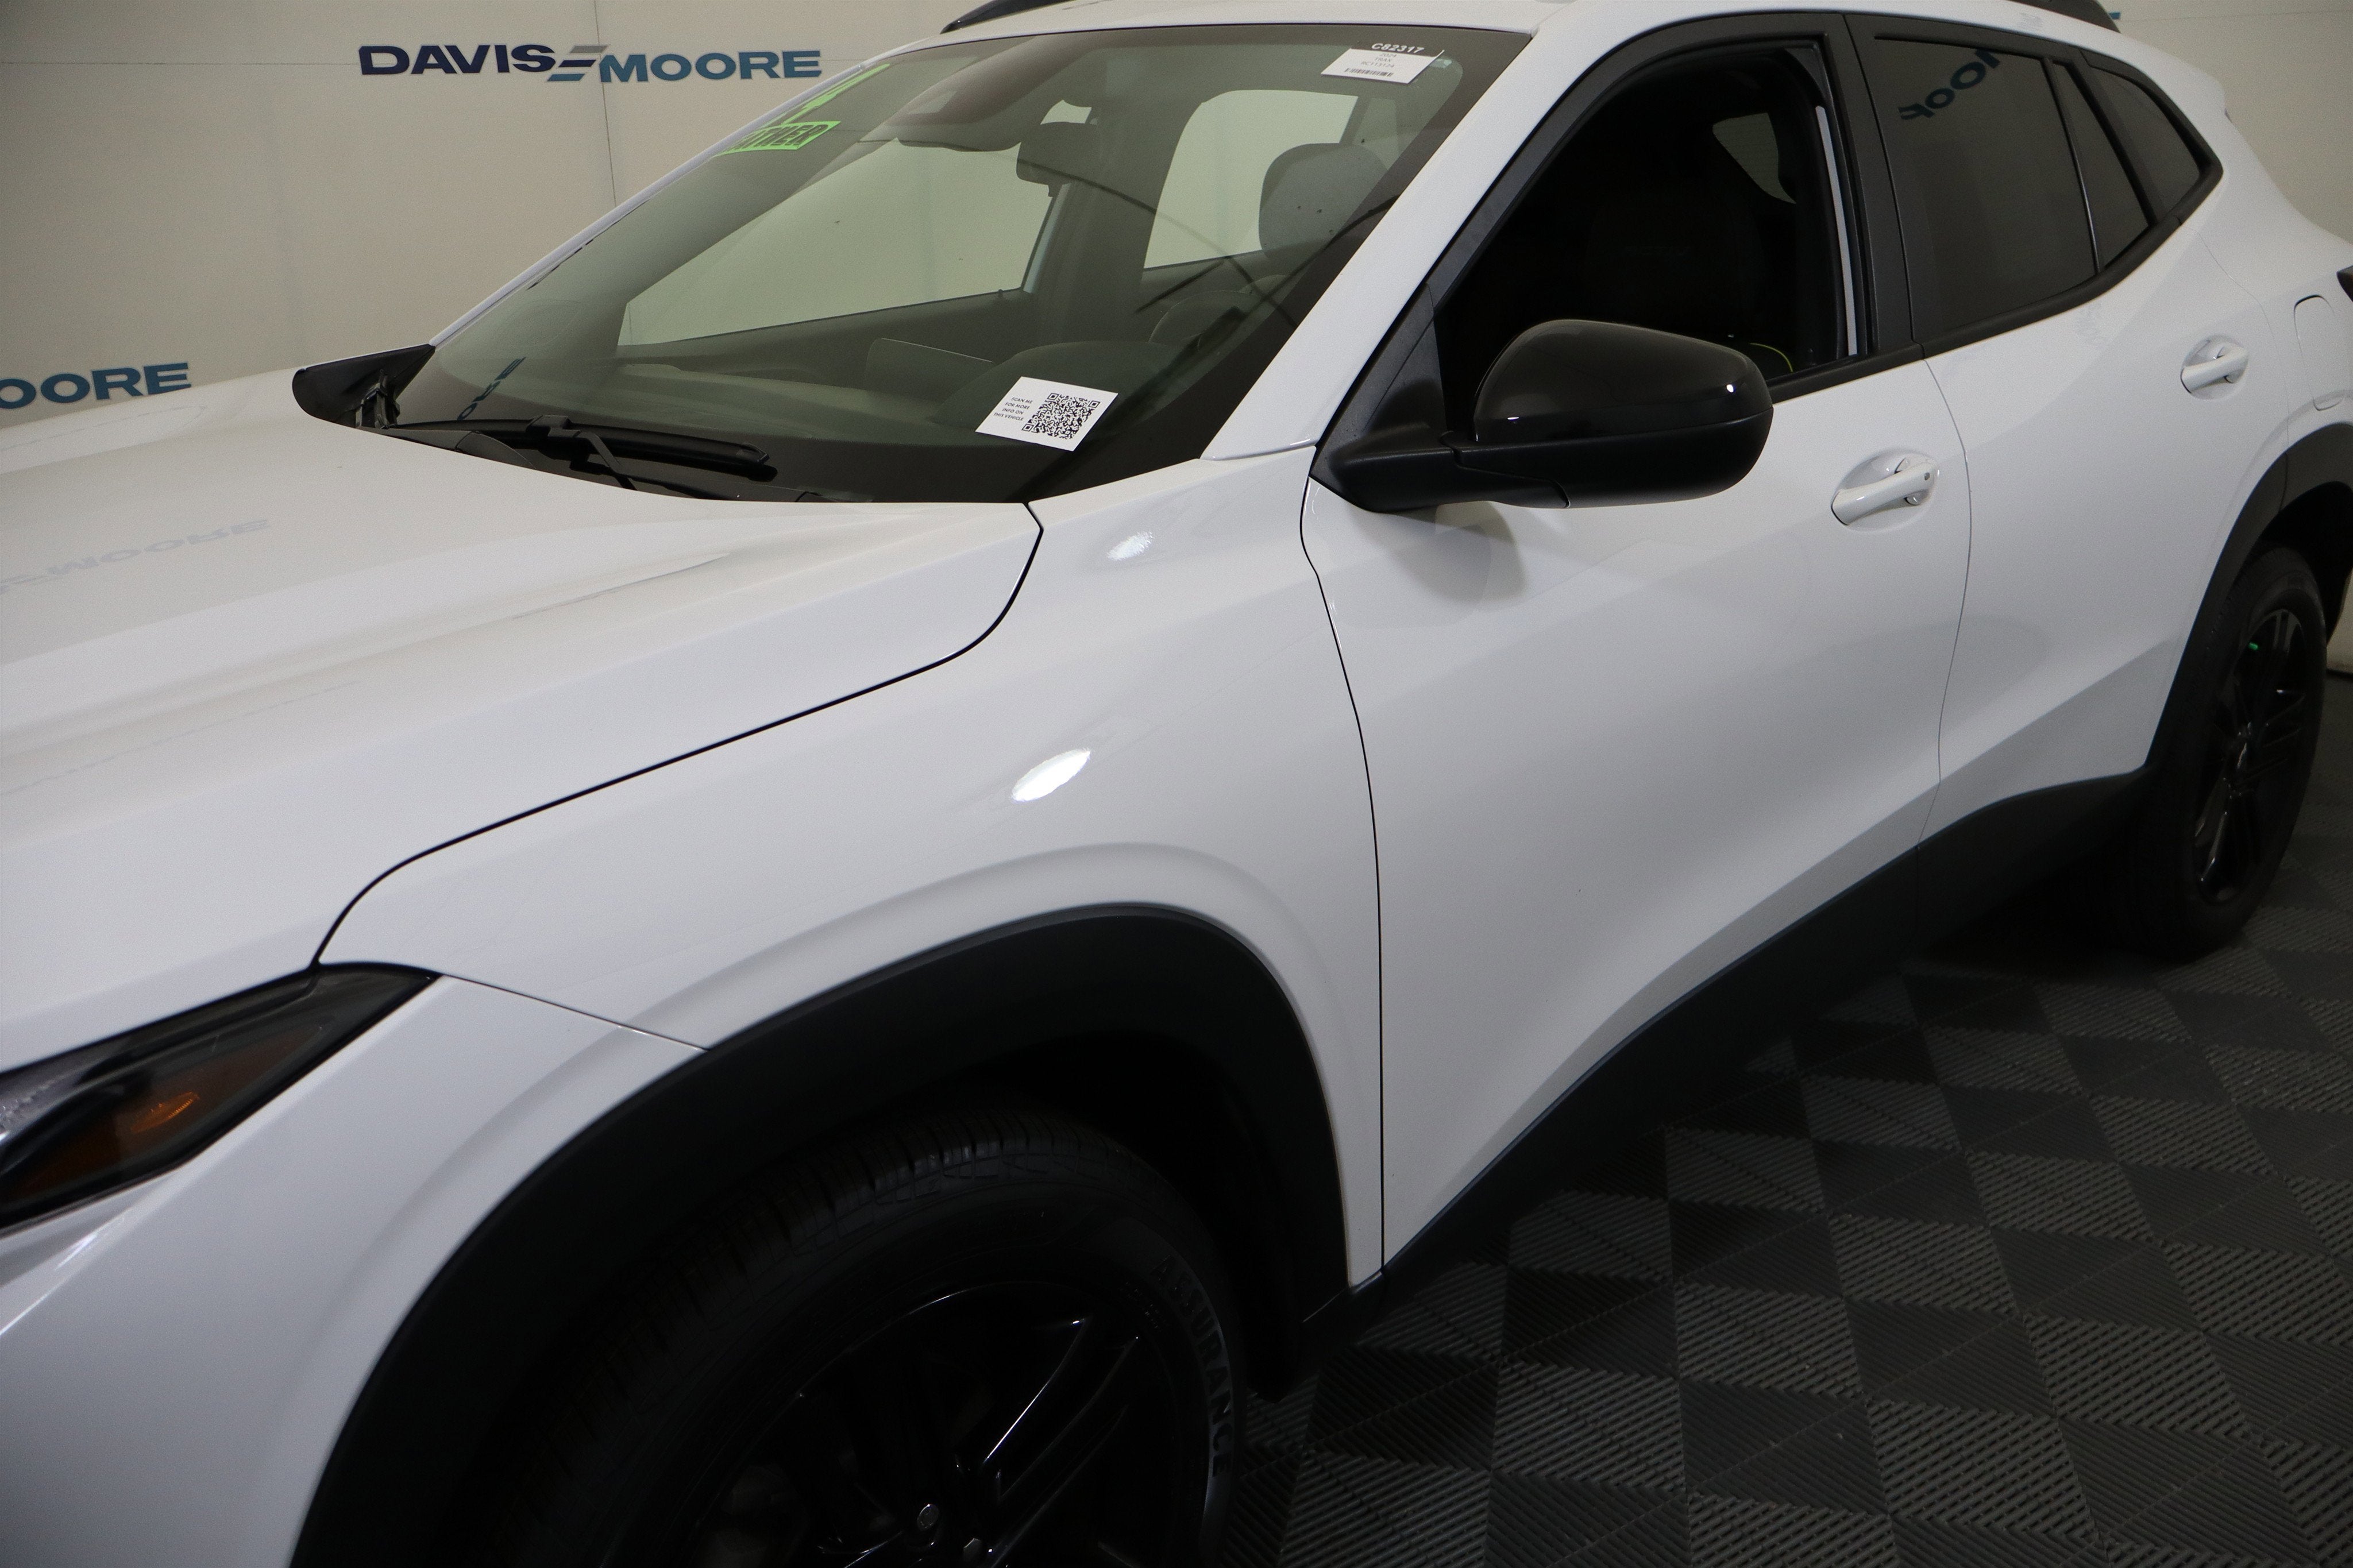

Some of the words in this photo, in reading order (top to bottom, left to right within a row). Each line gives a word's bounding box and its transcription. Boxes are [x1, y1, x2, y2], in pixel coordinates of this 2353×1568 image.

[1371, 43, 1425, 53] C82317
[358, 44, 556, 75] DAVIS
[599, 51, 821, 83] MOORE
